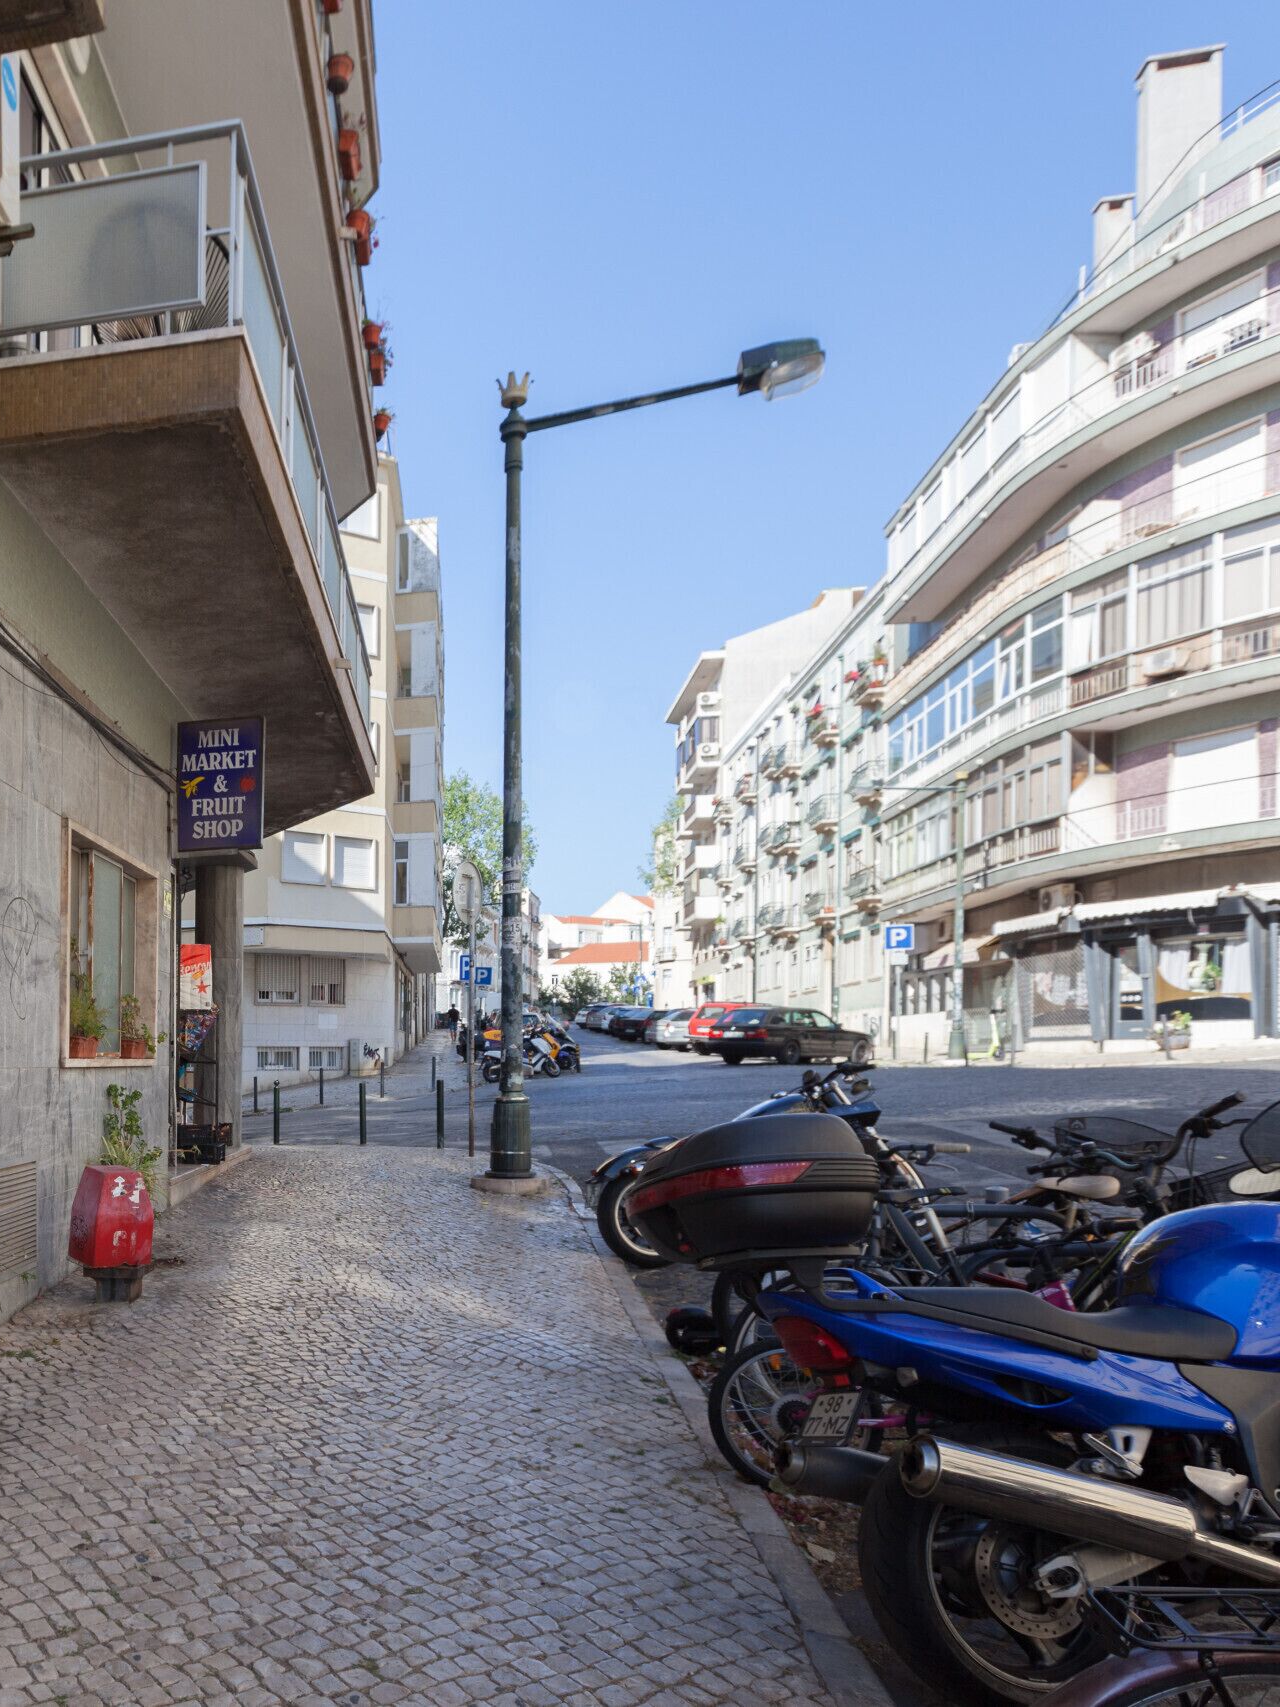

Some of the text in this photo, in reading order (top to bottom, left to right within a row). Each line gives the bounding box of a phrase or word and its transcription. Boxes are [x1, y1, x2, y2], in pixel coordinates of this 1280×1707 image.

[197, 728, 240, 749] MINI
[181, 749, 257, 773] MARKET
[213, 774, 229, 793] &
[191, 796, 246, 817] FRUIT
[192, 819, 244, 839] SHOP
[890, 928, 907, 947] P
[476, 969, 488, 983] P
